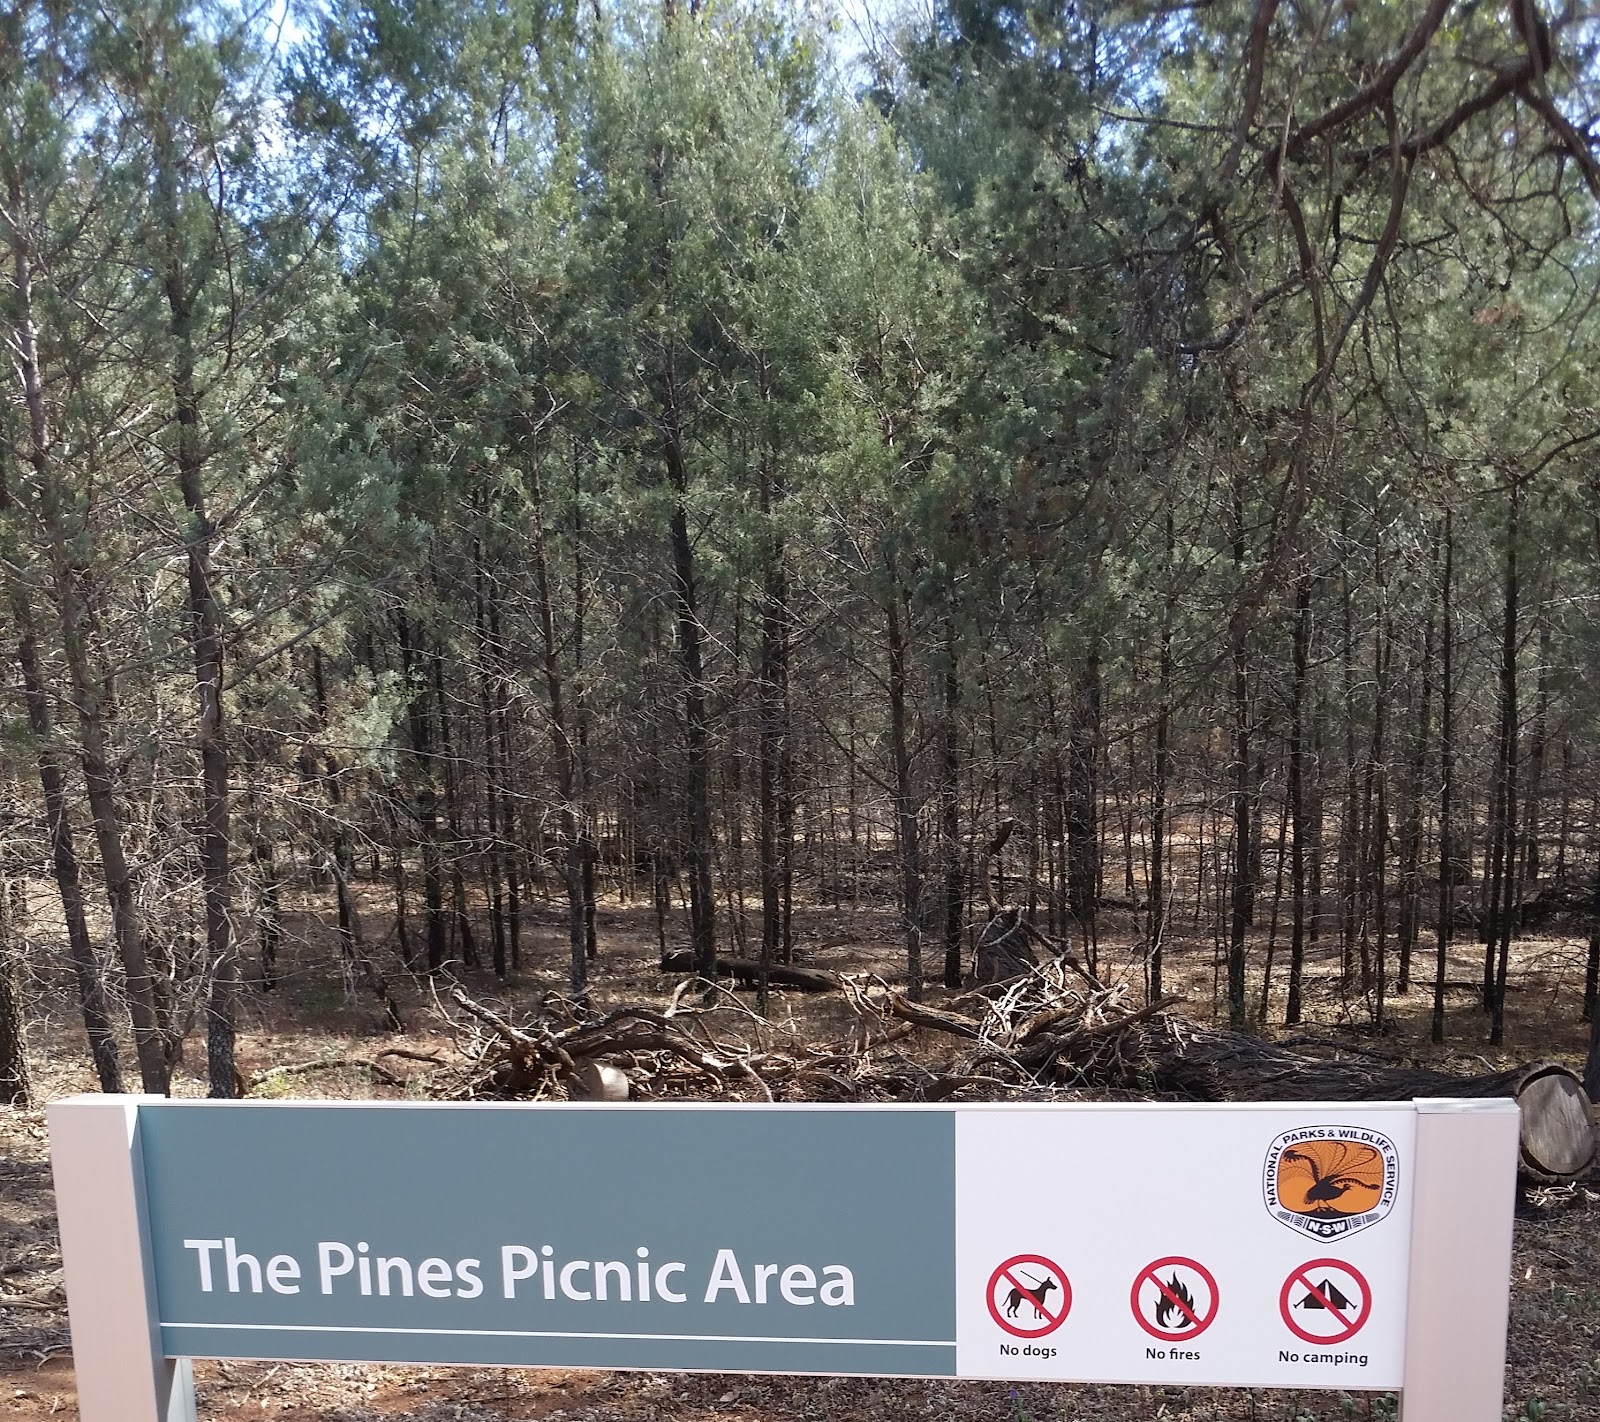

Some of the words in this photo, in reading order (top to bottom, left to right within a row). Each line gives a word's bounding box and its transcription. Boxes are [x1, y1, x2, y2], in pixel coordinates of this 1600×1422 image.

[1266, 1144, 1283, 1206] NATIONAL
[1282, 1129, 1325, 1144] PARKS
[1327, 1129, 1335, 1138] &
[1338, 1129, 1392, 1154] WILDLIFE
[1380, 1155, 1395, 1208] SERVICE
[183, 1237, 301, 1295] The
[317, 1240, 484, 1299] Pines
[500, 1244, 686, 1303] Picnic
[703, 1248, 855, 1307] Area
[1000, 1344, 1020, 1357] No
[1022, 1344, 1058, 1360] dogs
[1145, 1347, 1167, 1360] No
[1169, 1347, 1201, 1361] fires
[1278, 1350, 1301, 1363] No
[1303, 1351, 1369, 1367] camping
